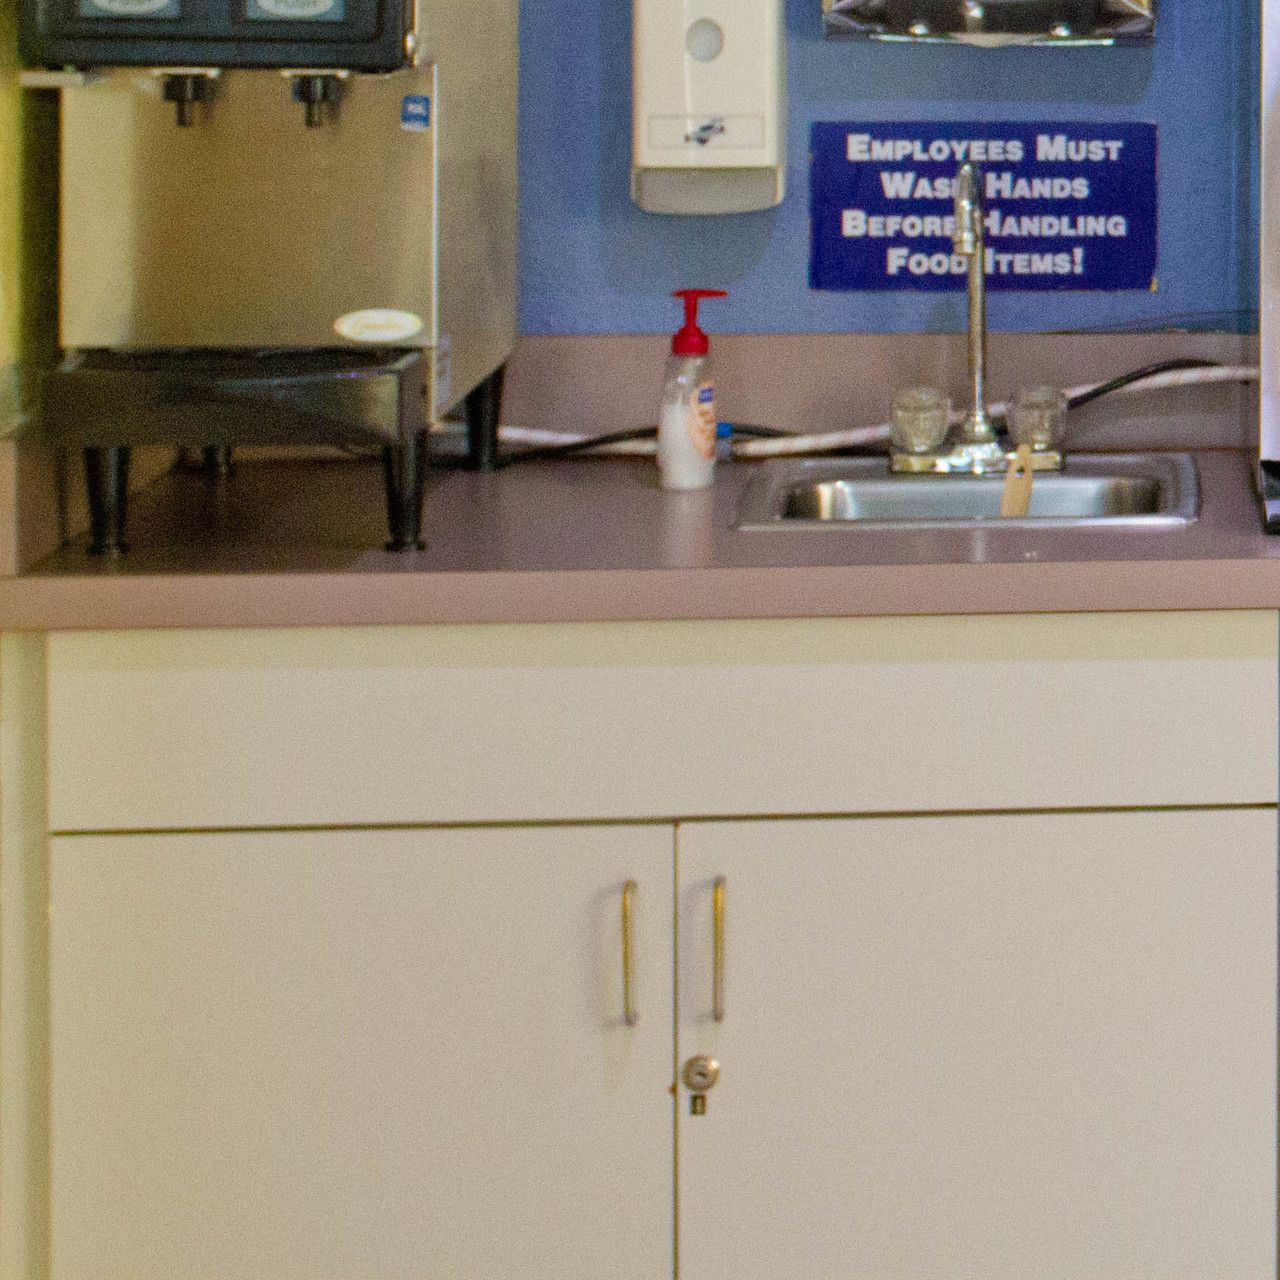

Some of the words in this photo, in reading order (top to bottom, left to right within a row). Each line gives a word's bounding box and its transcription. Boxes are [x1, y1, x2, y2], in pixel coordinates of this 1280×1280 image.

[847, 133, 1024, 162] EMPLOYEES
[1036, 134, 1123, 162] MUST
[984, 171, 1090, 200] HANDS
[841, 209, 958, 238] BEFORE
[886, 247, 968, 275] FOOD
[985, 246, 1084, 275] ITEMS!
